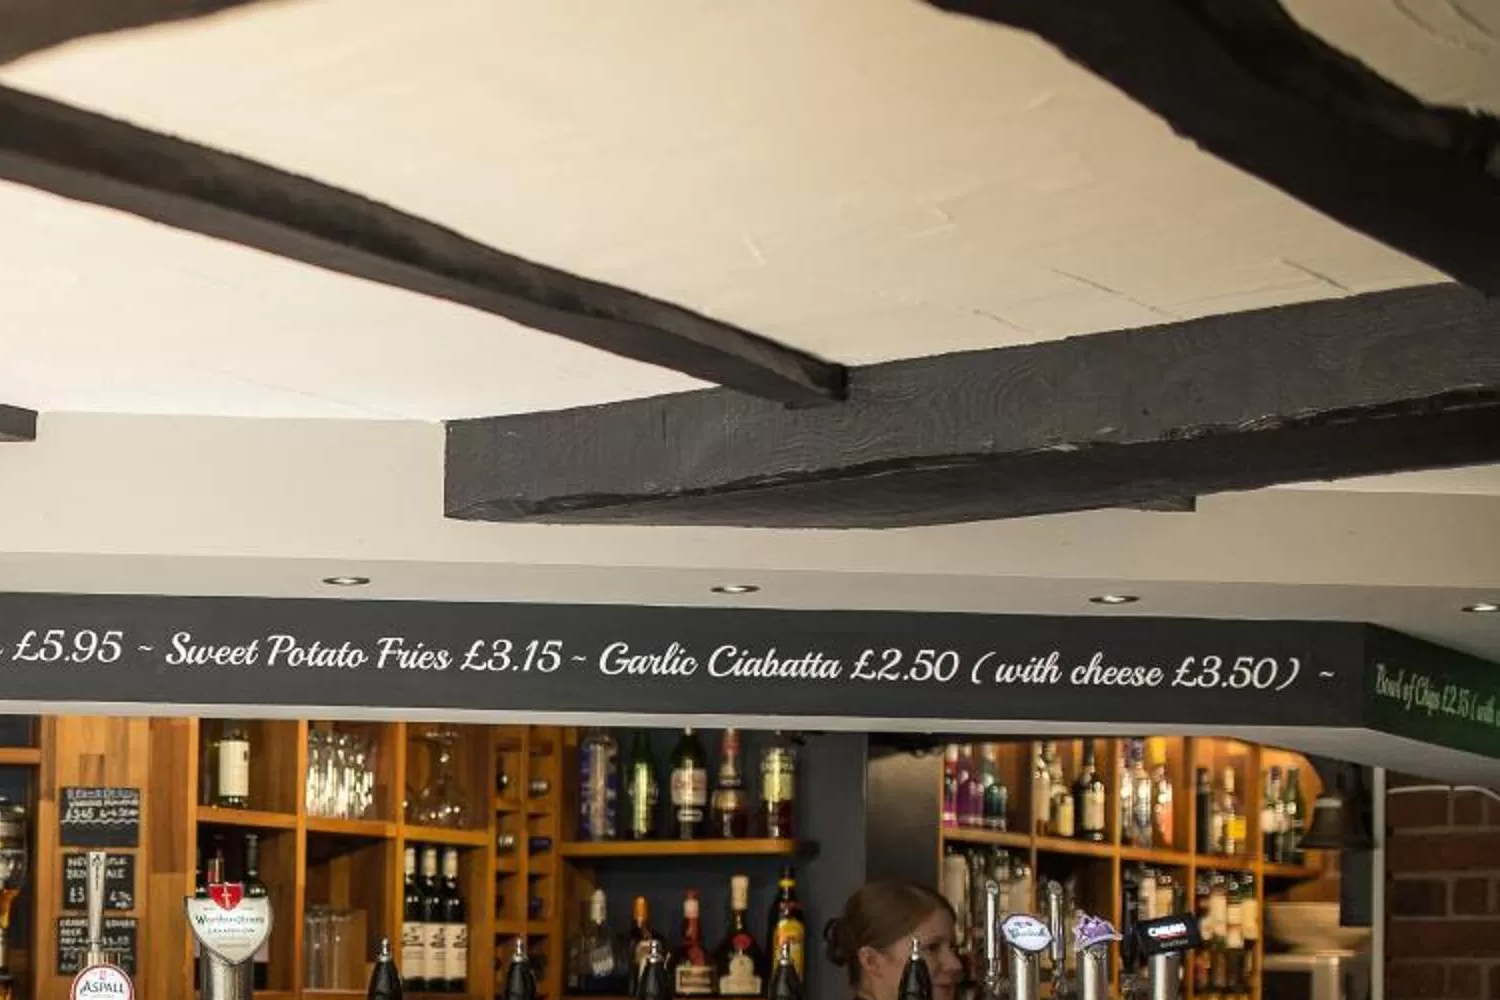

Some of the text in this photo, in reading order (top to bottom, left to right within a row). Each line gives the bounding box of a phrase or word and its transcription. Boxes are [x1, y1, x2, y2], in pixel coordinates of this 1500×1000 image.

[11, 629, 124, 663] £5.95
[165, 631, 260, 666] Sweet
[266, 634, 369, 669] Potato
[376, 637, 454, 671] Fries
[459, 639, 563, 673] £3.15
[598, 641, 699, 676] Garlic
[707, 644, 843, 679] Ciabatta
[849, 647, 960, 682] £2.50
[1070, 651, 1164, 687] cheese
[1171, 655, 1300, 691] £3.50)
[80, 980, 124, 994] ASPALL
